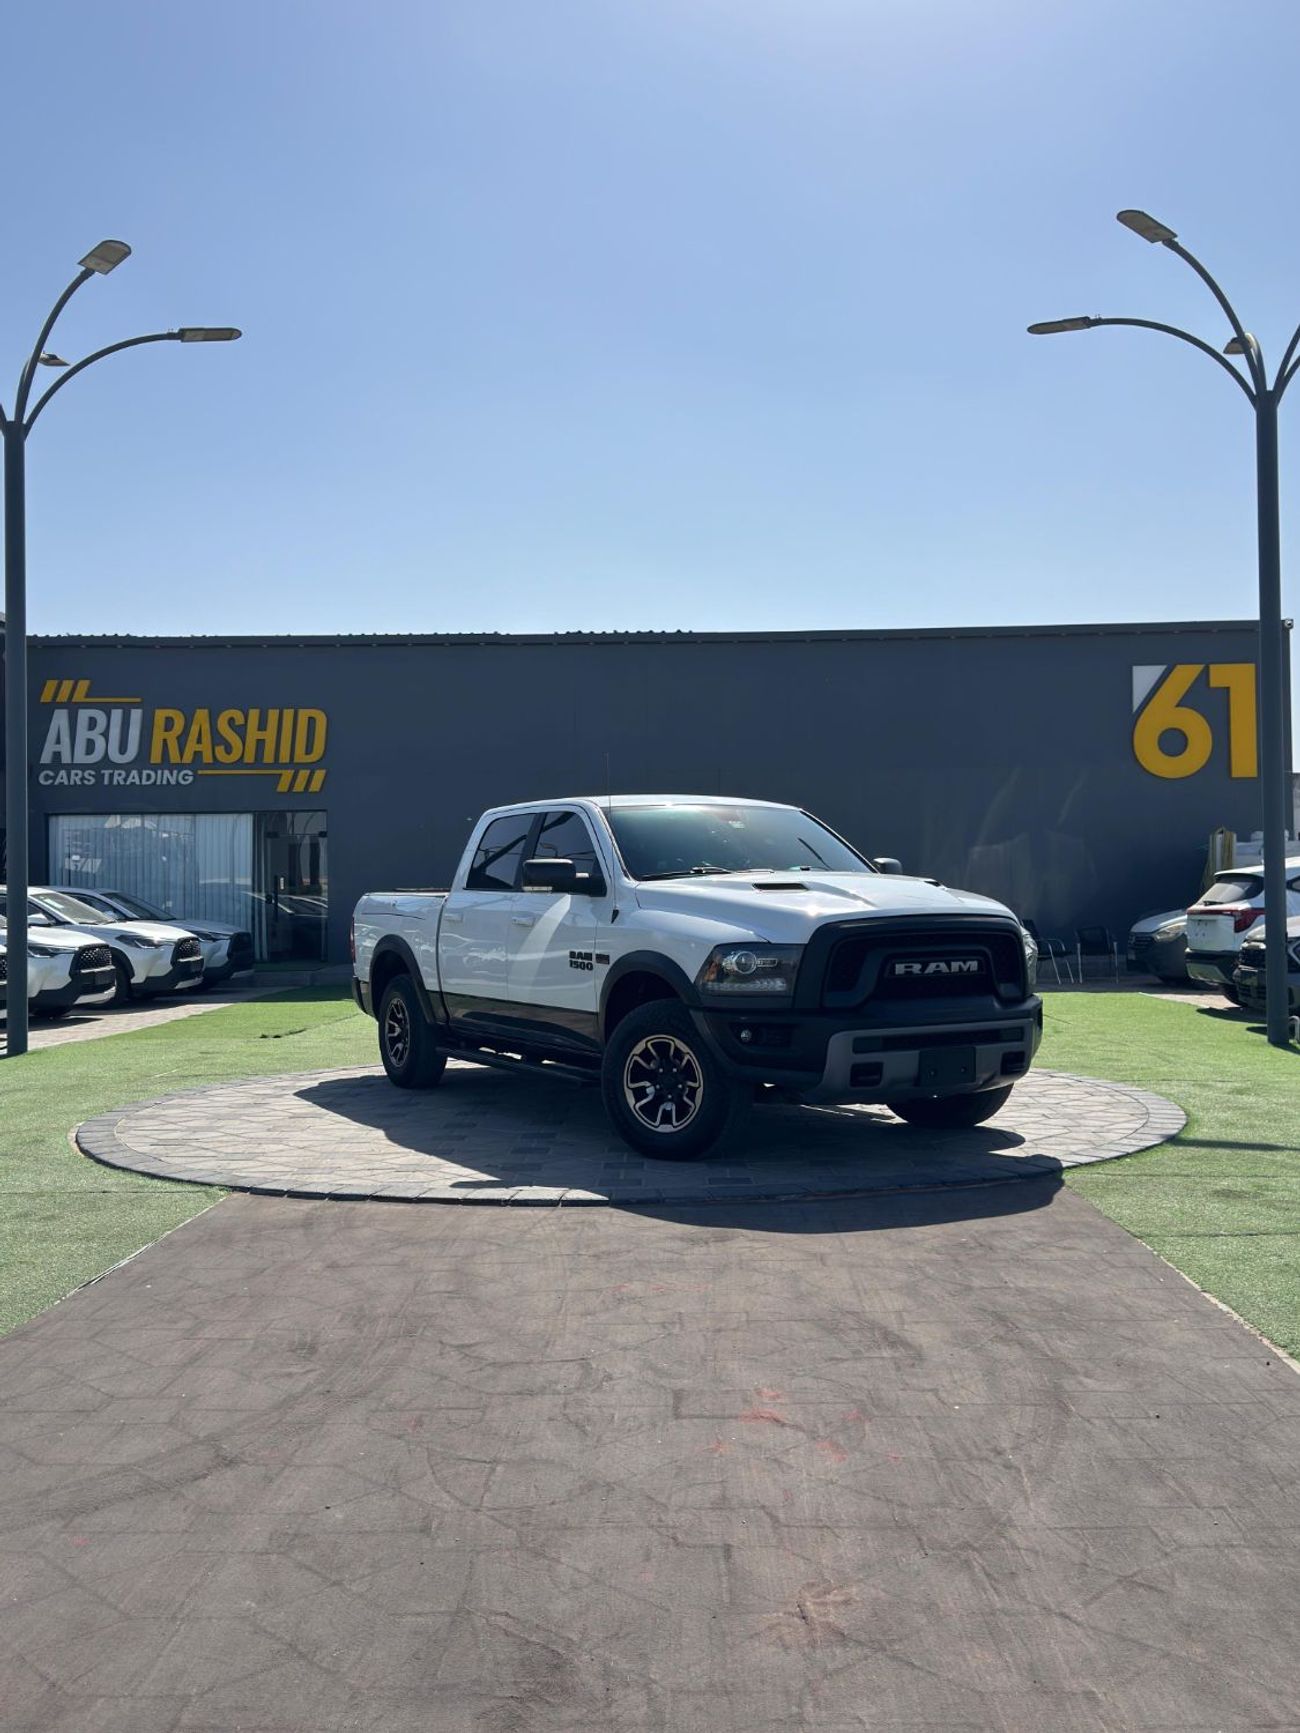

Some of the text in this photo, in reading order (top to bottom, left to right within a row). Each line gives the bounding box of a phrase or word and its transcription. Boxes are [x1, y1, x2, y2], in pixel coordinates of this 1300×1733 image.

[1132, 663, 1258, 779] 61
[39, 708, 328, 765] ABU RASHID
[38, 769, 195, 786] CARS TRADING
[569, 959, 594, 971] 1500
[895, 960, 979, 975] RAM
